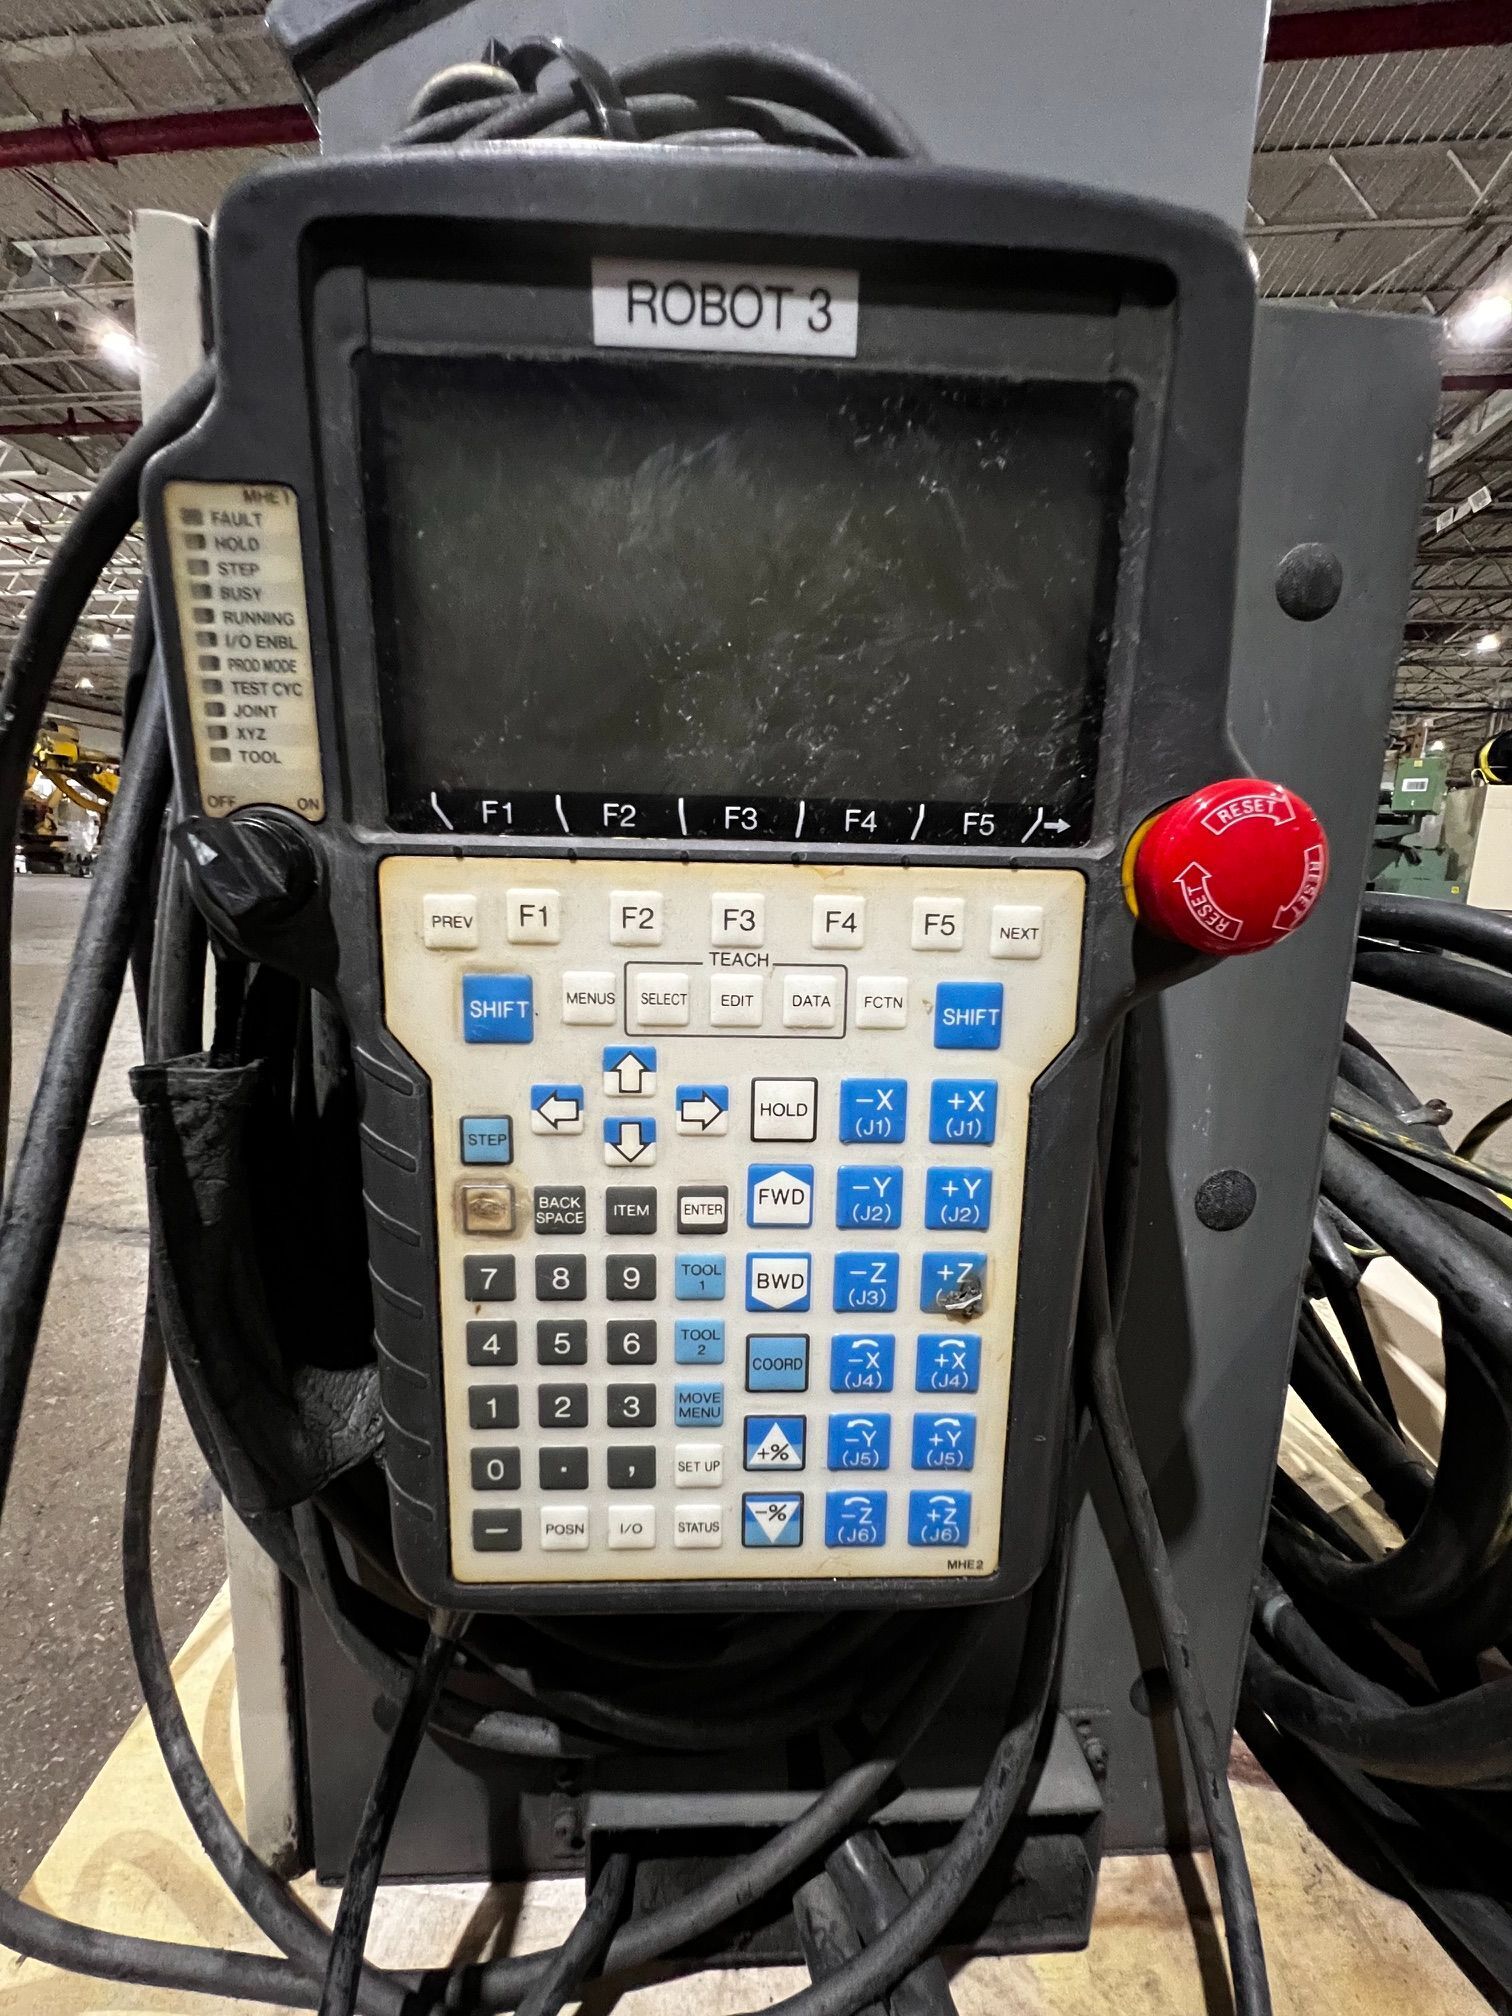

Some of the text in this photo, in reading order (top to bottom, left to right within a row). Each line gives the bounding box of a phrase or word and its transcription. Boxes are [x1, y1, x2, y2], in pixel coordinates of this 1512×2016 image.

[627, 279, 831, 332] ROBOT 3
[210, 511, 263, 527] FAULT
[214, 537, 260, 552] HOLD
[216, 562, 260, 577] STEP
[220, 587, 262, 601] BUSY
[222, 611, 295, 626] RUNNING
[225, 635, 297, 649] I/O ENBL
[228, 658, 296, 673] PROD MODE
[231, 682, 302, 697] TEST CYC
[234, 705, 277, 718] JOINT
[237, 728, 266, 741] XYZ
[239, 750, 281, 764] TOOL
[207, 796, 236, 808] OFF
[297, 798, 319, 811] ON
[482, 801, 512, 824] F1
[603, 804, 636, 827] F2
[725, 807, 758, 830] F3
[1217, 800, 1276, 824] RESET
[845, 809, 877, 832] F4
[963, 812, 995, 836] F5
[520, 905, 548, 927] F1
[1187, 886, 1230, 933] RESET
[432, 916, 473, 928] PREV
[622, 907, 654, 929] F2
[723, 909, 756, 931] F3
[826, 911, 857, 933] F4
[925, 914, 956, 936] F5
[1000, 928, 1039, 940] NEXT
[709, 952, 769, 968] TEACH
[567, 992, 615, 1005] MENUS
[641, 993, 687, 1006] SELECT
[721, 995, 753, 1007] EDIT
[792, 995, 831, 1007] DATA
[864, 996, 903, 1008] FCTN
[470, 1001, 529, 1018] SHIFT
[942, 1008, 1000, 1026] SHIFT
[948, 1090, 985, 1112] +X
[760, 1103, 808, 1117] HOLD
[856, 1117, 891, 1137] (J1)
[946, 1118, 981, 1138] (J1)
[468, 1134, 507, 1146] STEP
[759, 1188, 804, 1205] FWD
[942, 1178, 981, 1199] +Y
[539, 1197, 580, 1209] BACK
[614, 1205, 649, 1216] ITEM
[684, 1205, 723, 1215] ENTER
[536, 1212, 584, 1225] SPACE
[853, 1203, 891, 1224] (J2)
[941, 1205, 980, 1225] (J2)
[622, 1267, 640, 1289] 9
[681, 1264, 722, 1276] TOOL
[480, 1268, 498, 1290] 7
[552, 1267, 570, 1290] 8
[699, 1281, 705, 1290] 1
[757, 1273, 804, 1290] BWD
[849, 1288, 886, 1307] (J3)
[681, 1329, 720, 1341] TOOL
[482, 1333, 501, 1355] 4
[554, 1332, 571, 1355] 5
[622, 1332, 641, 1355] 6
[697, 1345, 706, 1355] 2
[752, 1358, 802, 1370] COORD
[934, 1352, 966, 1369] +X
[845, 1372, 882, 1389] (J4)
[931, 1373, 968, 1390] (J4)
[679, 1393, 720, 1404] MOVE
[486, 1398, 497, 1418] 1
[555, 1396, 571, 1418] 2
[622, 1396, 640, 1418] 3
[679, 1407, 721, 1418] MENU
[929, 1430, 961, 1448] +Y
[678, 1461, 720, 1472] SET UP
[842, 1452, 879, 1468] (J5)
[926, 1452, 963, 1468] (J5)
[487, 1459, 505, 1481] 0
[927, 1508, 957, 1525] +Z
[546, 1525, 585, 1535] POSN
[620, 1523, 643, 1534] I/O
[678, 1522, 720, 1533] STATUS
[838, 1527, 877, 1543] (J6)
[921, 1527, 960, 1543] (J6)
